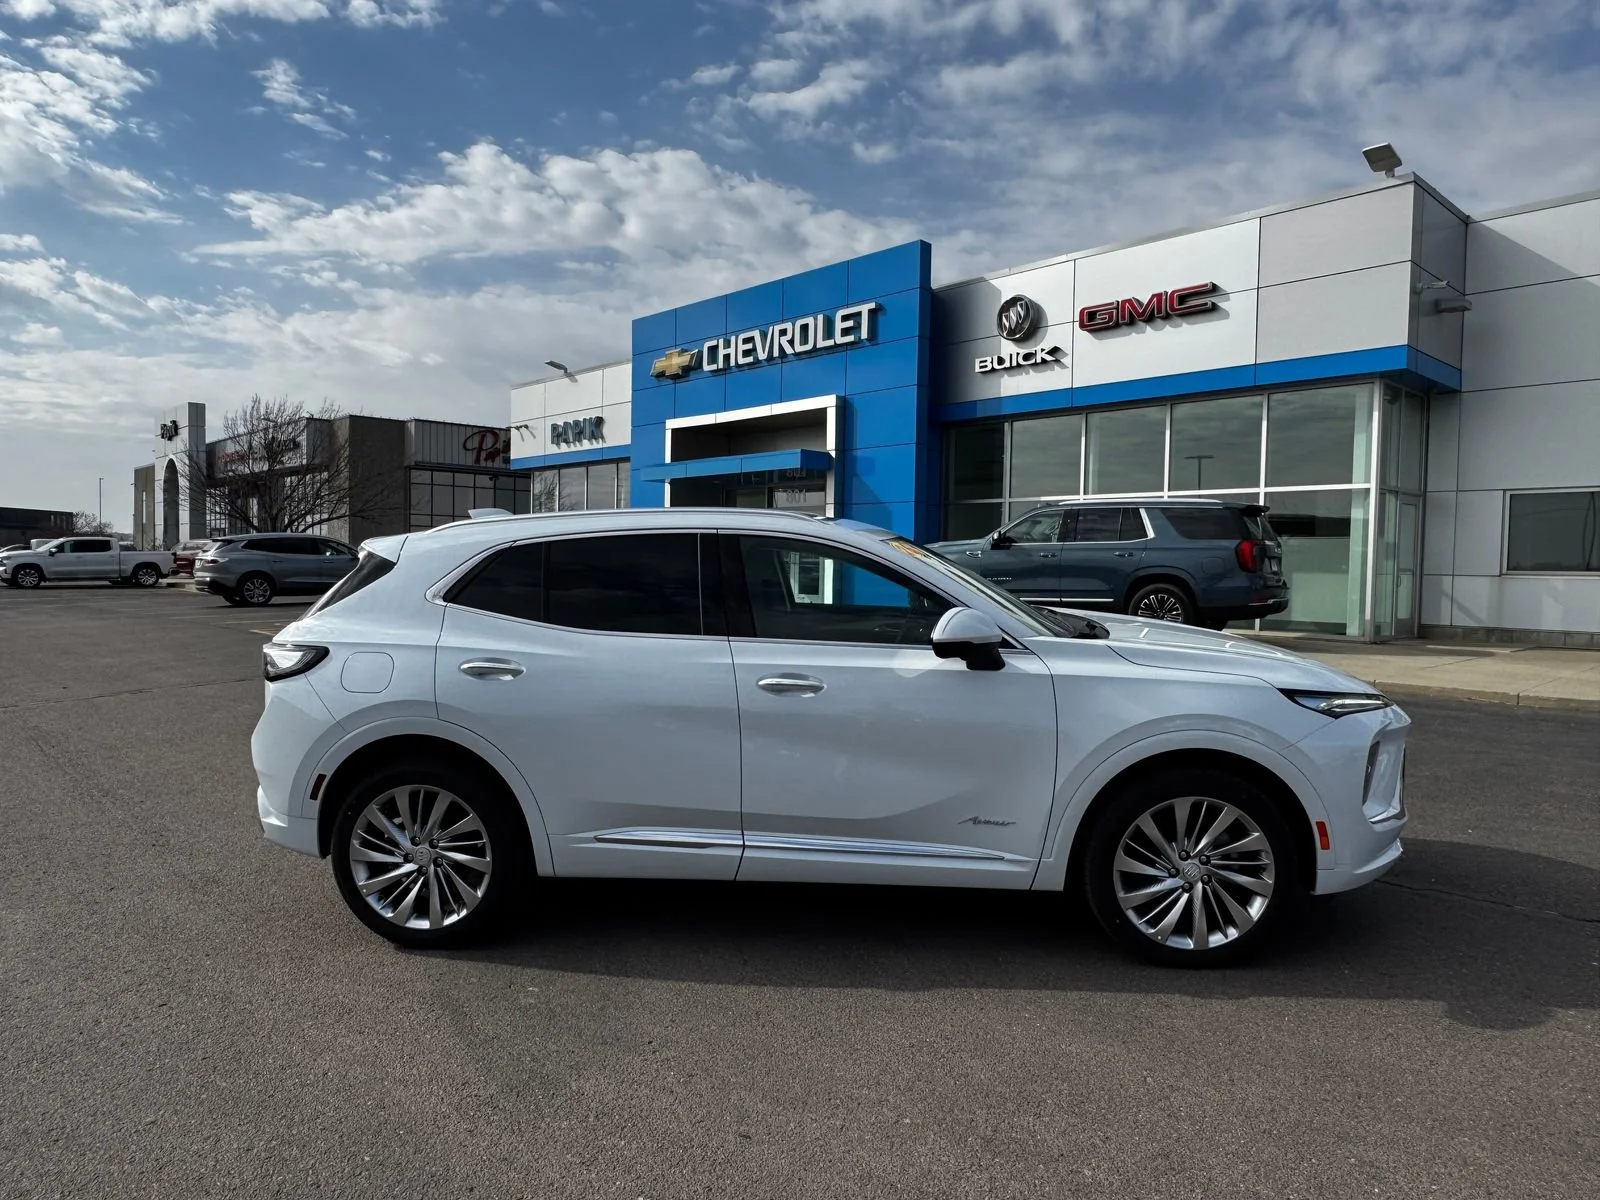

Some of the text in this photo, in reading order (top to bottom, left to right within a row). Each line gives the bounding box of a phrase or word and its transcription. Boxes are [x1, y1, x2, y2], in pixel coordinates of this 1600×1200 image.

[1078, 281, 1214, 332] GMC
[702, 301, 877, 372] CHEVROLET
[974, 346, 1058, 374] BUICK
